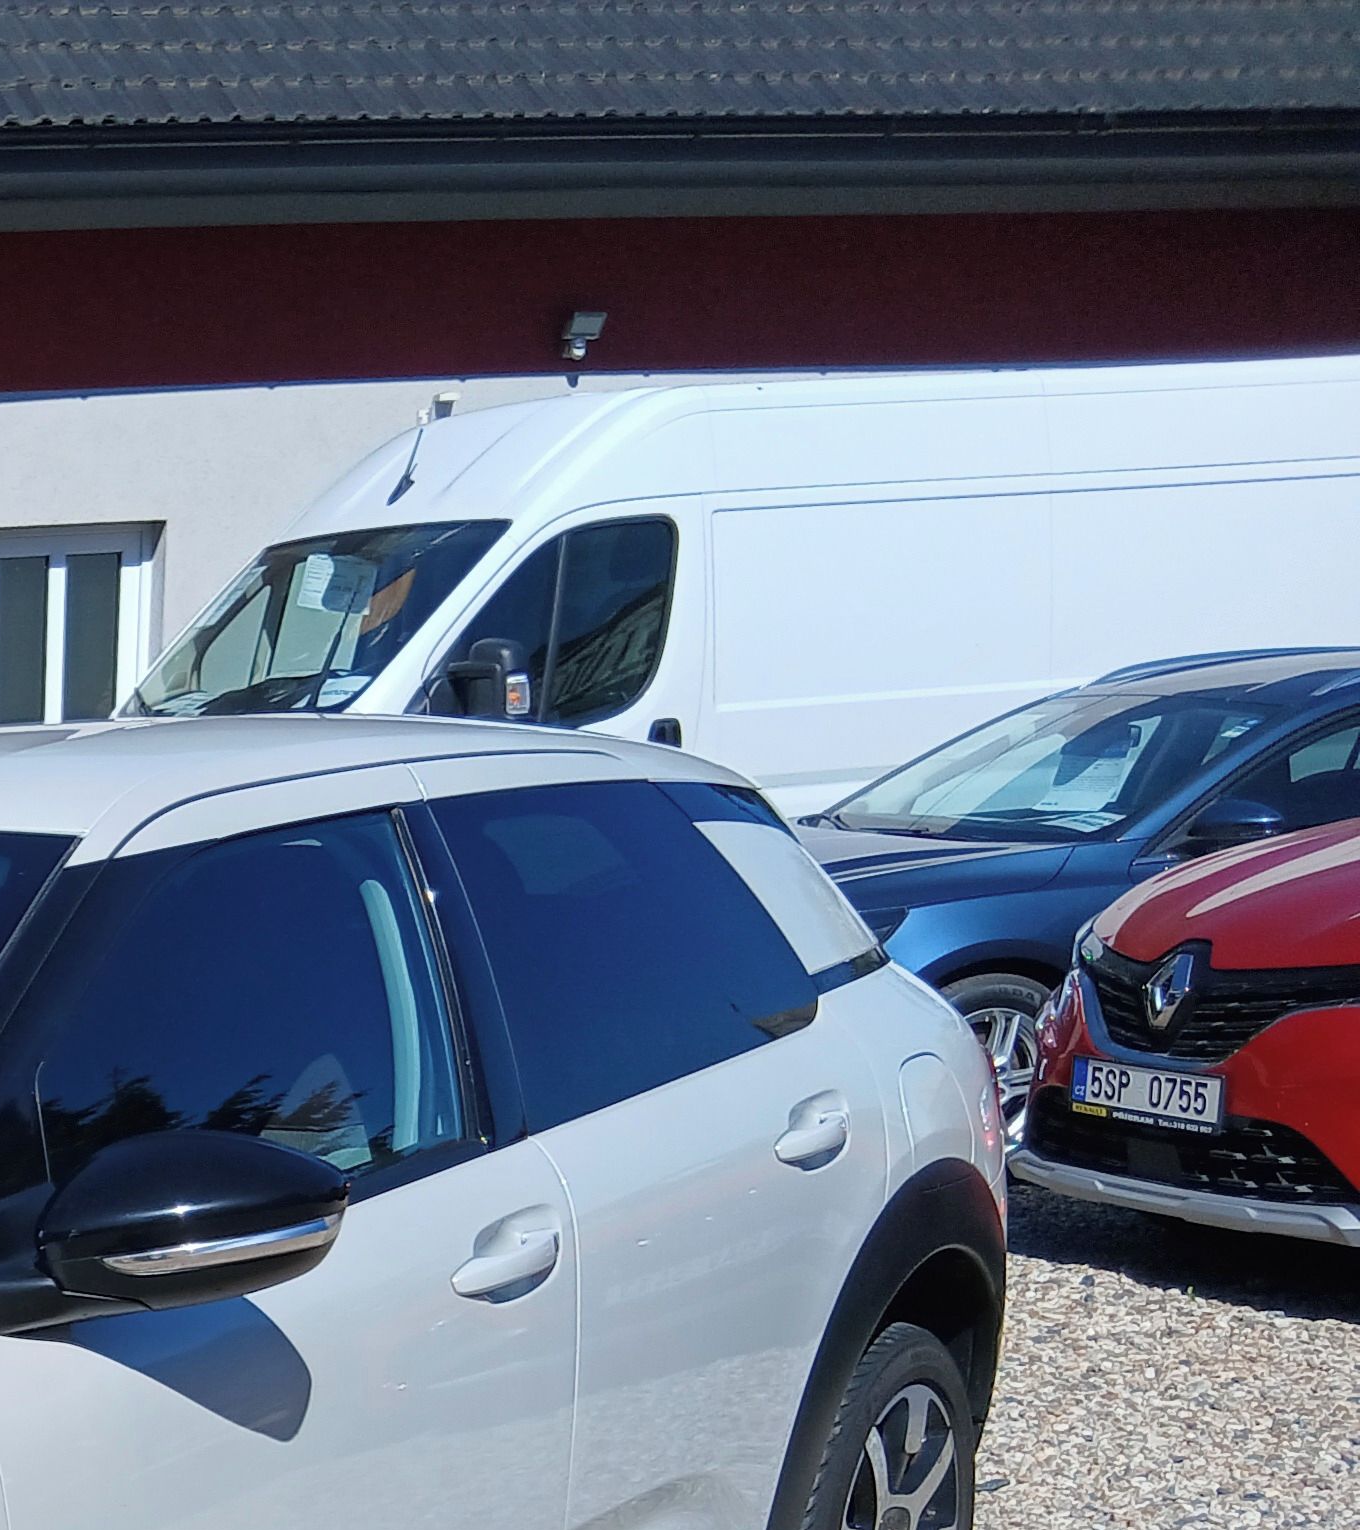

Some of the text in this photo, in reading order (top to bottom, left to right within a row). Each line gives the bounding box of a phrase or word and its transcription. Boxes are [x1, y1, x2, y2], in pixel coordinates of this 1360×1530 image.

[1074, 1085, 1085, 1096] CZ
[1091, 1066, 1208, 1116] 5SP 0755
